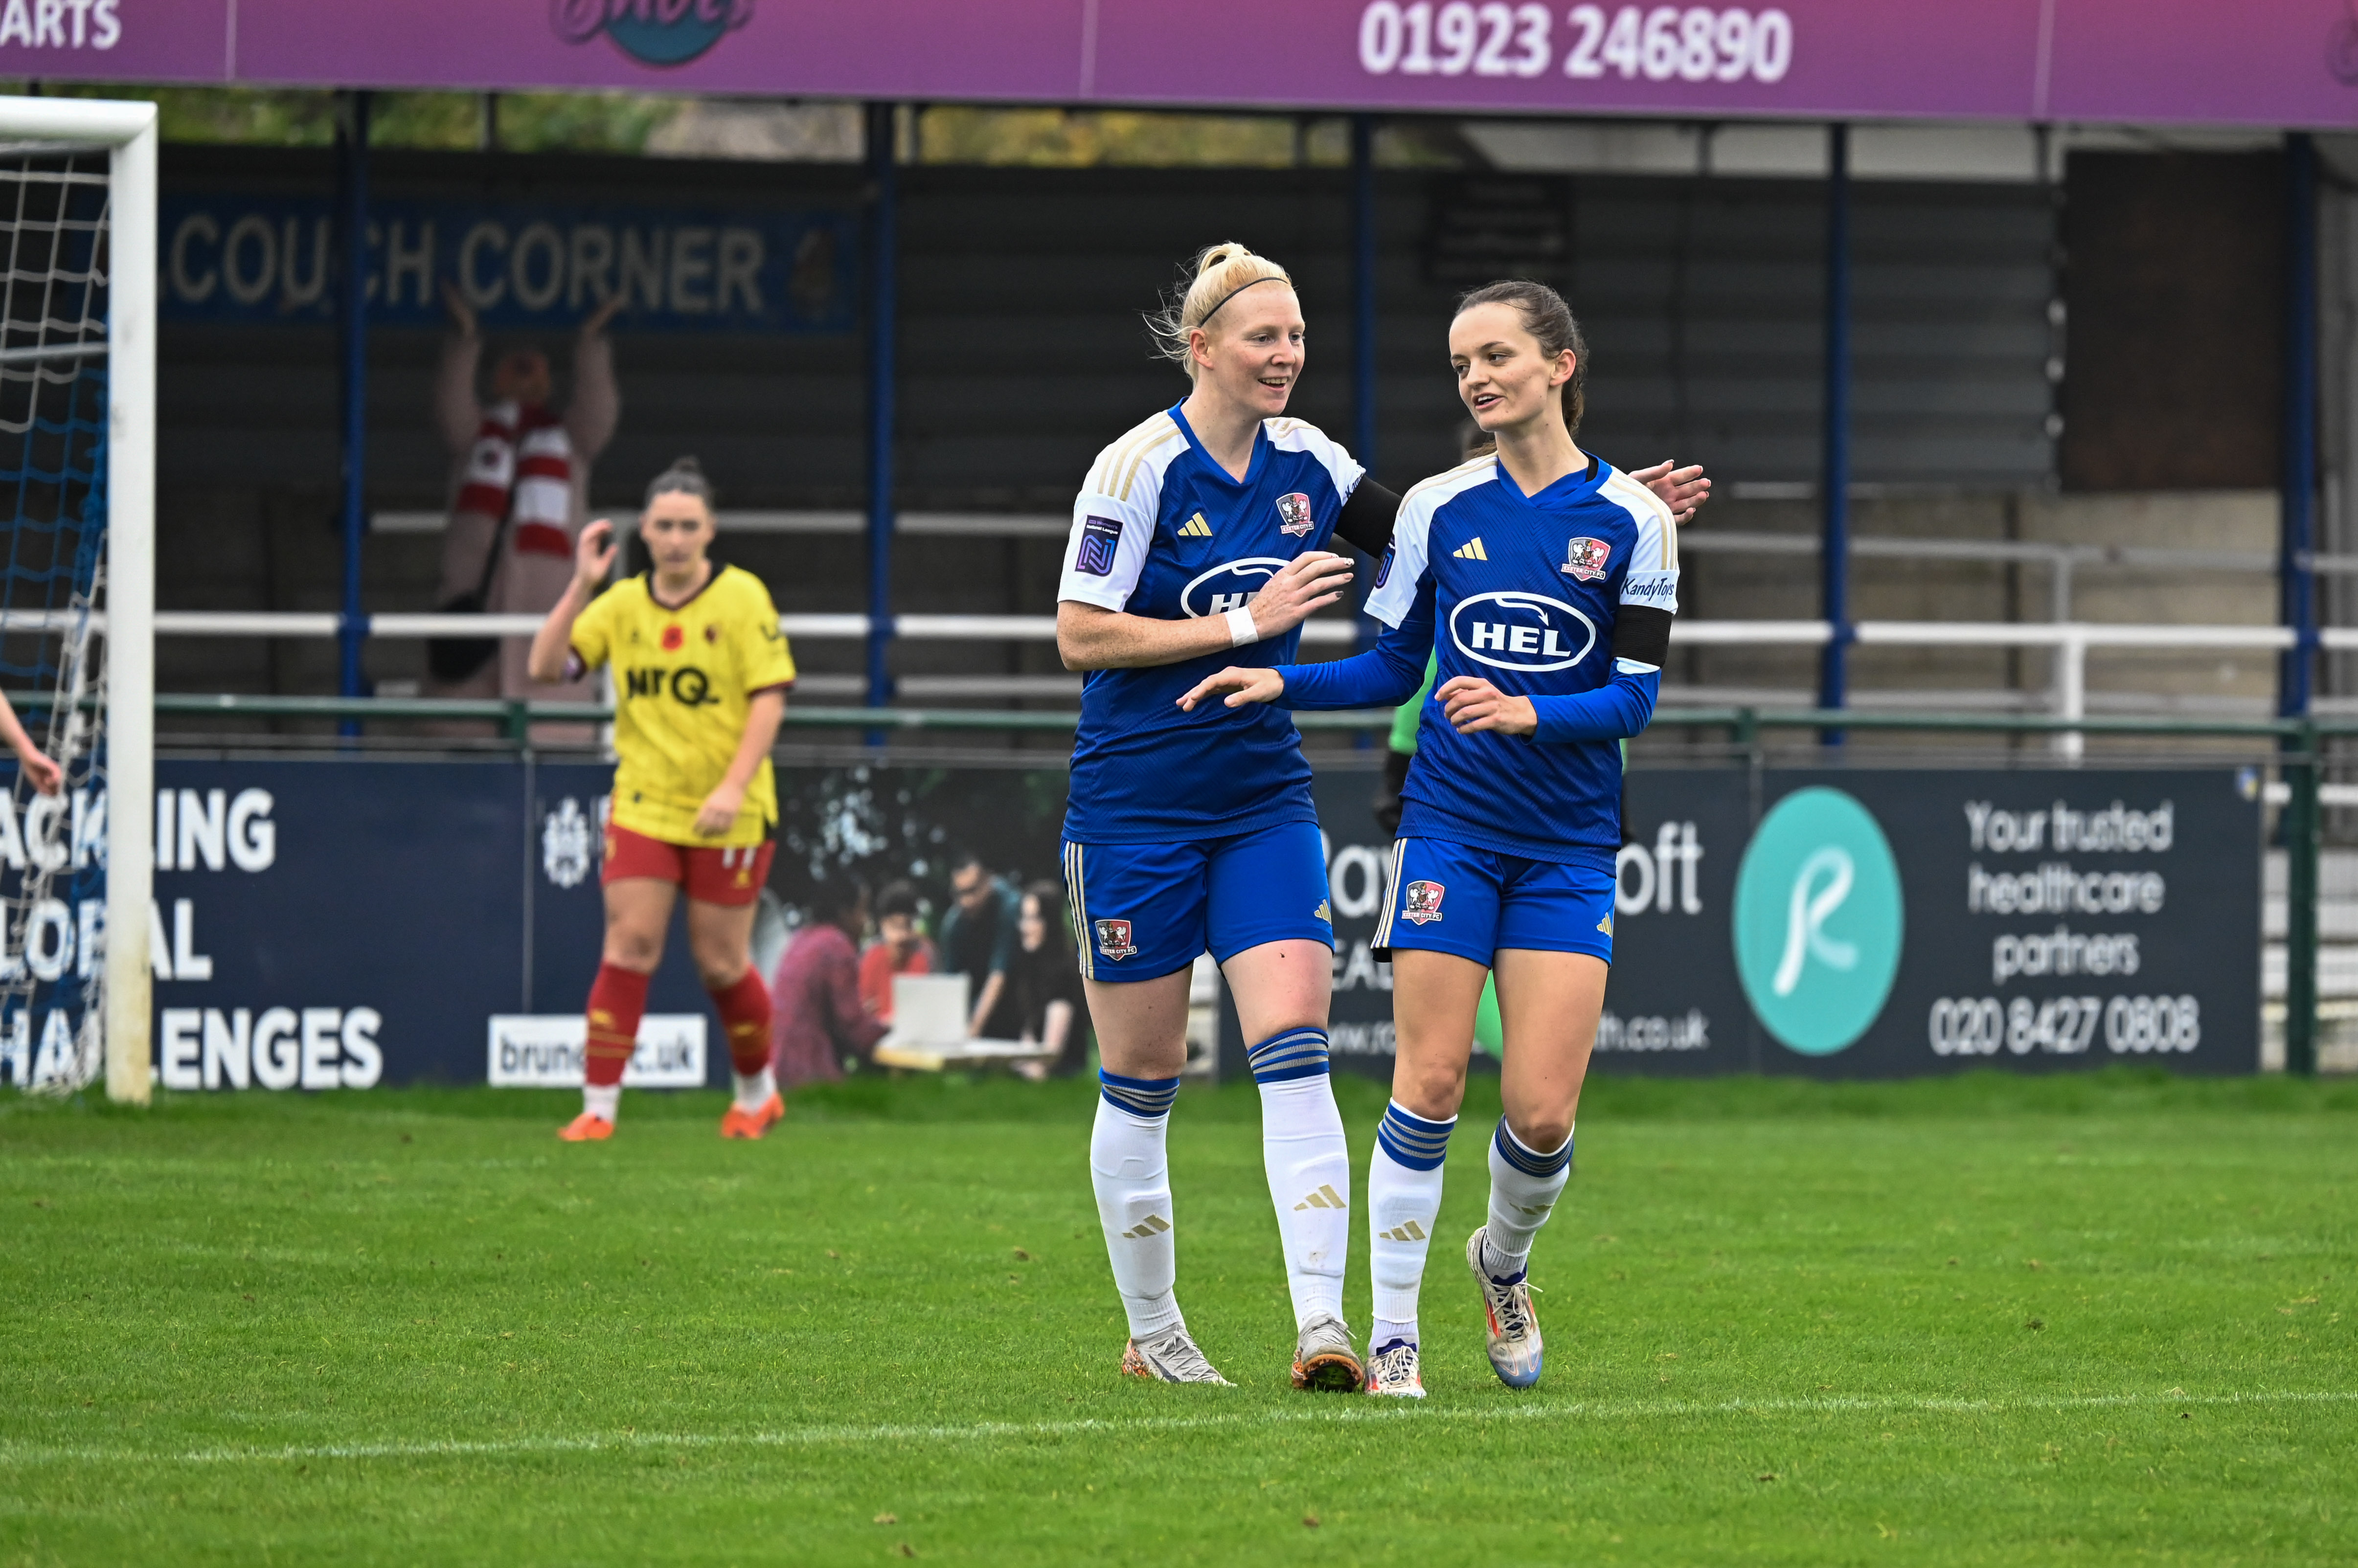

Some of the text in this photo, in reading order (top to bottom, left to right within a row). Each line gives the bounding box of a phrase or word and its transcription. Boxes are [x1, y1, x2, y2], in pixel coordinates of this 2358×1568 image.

[0, 0, 121, 50] ARTS
[1360, 0, 1792, 82] 01923 246890
[459, 223, 764, 313] CORNER
[1621, 578, 1674, 602] KandyToys
[1472, 622, 1571, 657] HEL
[1965, 799, 2173, 852] Your trusted
[1969, 862, 2166, 914] healthcare
[1994, 926, 2140, 984] partners
[1930, 995, 2199, 1055] 020 8427 0808
